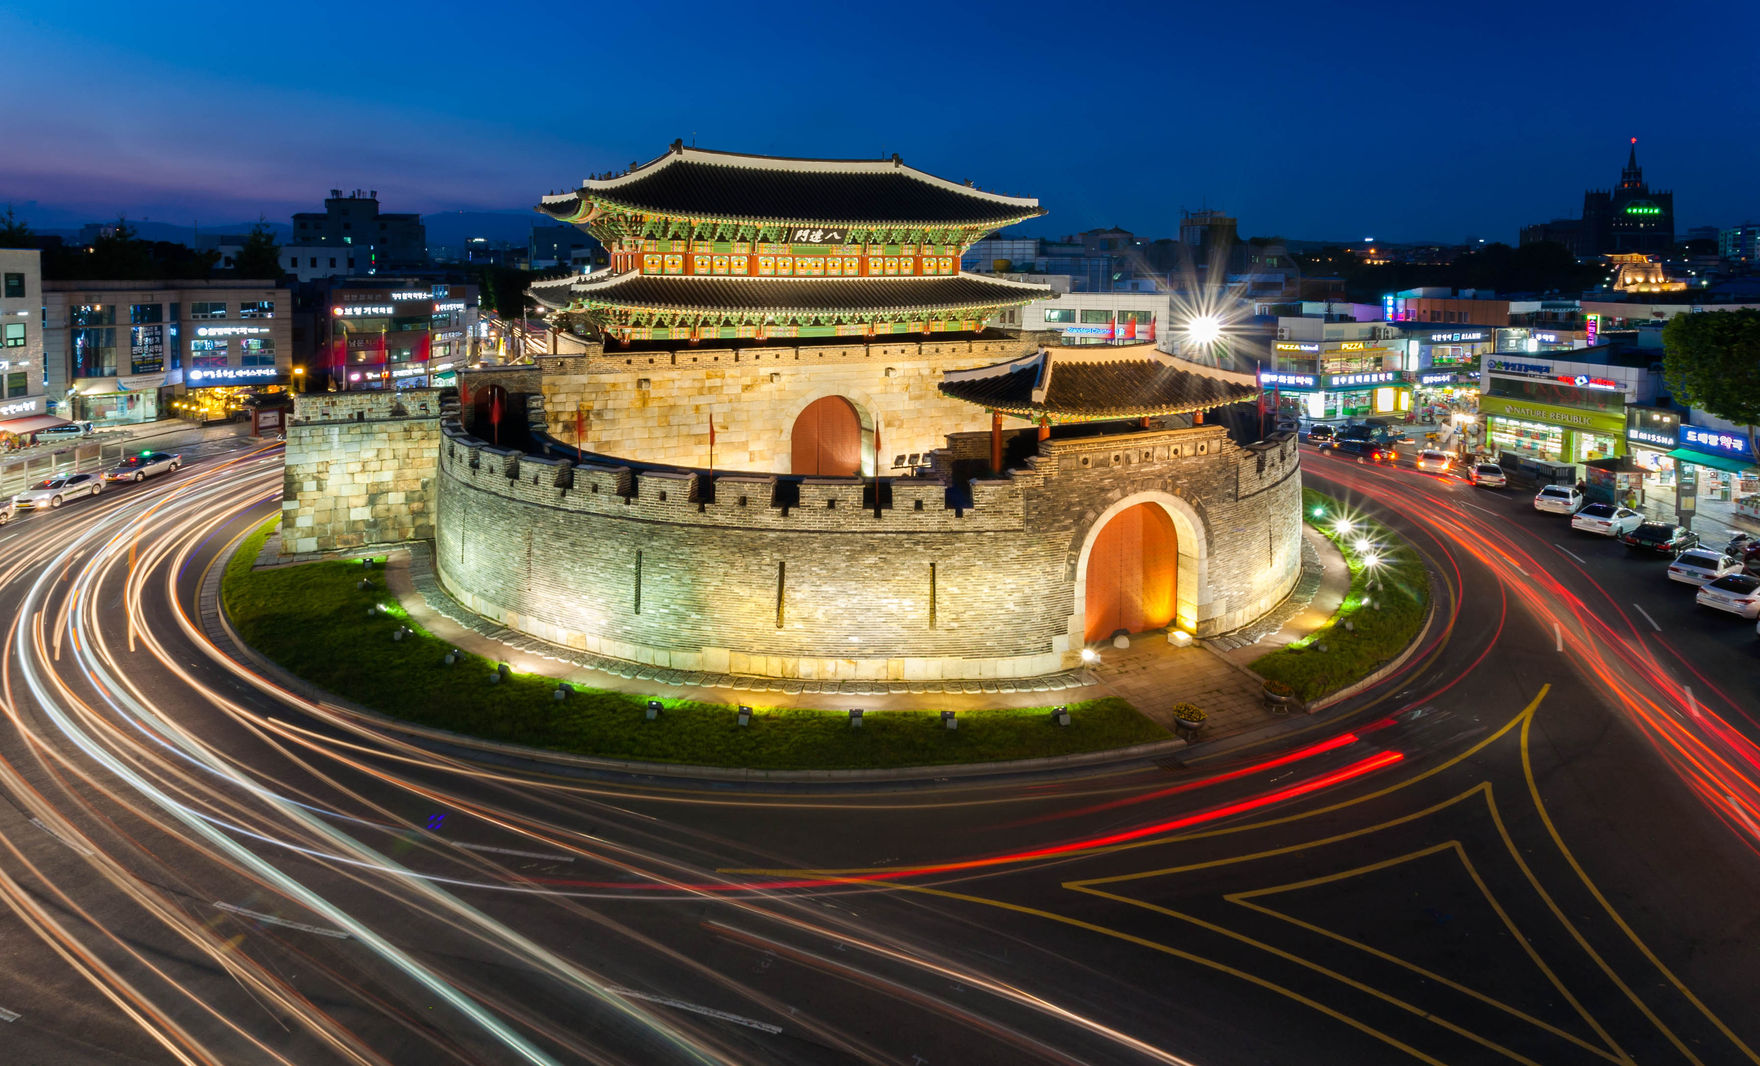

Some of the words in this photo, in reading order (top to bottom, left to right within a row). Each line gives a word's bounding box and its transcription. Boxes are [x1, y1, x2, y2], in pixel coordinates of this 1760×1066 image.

[1513, 407, 1547, 419] NATURE
[1550, 413, 1592, 425] REPUBLIC
[1639, 432, 1674, 445] MISSHA
